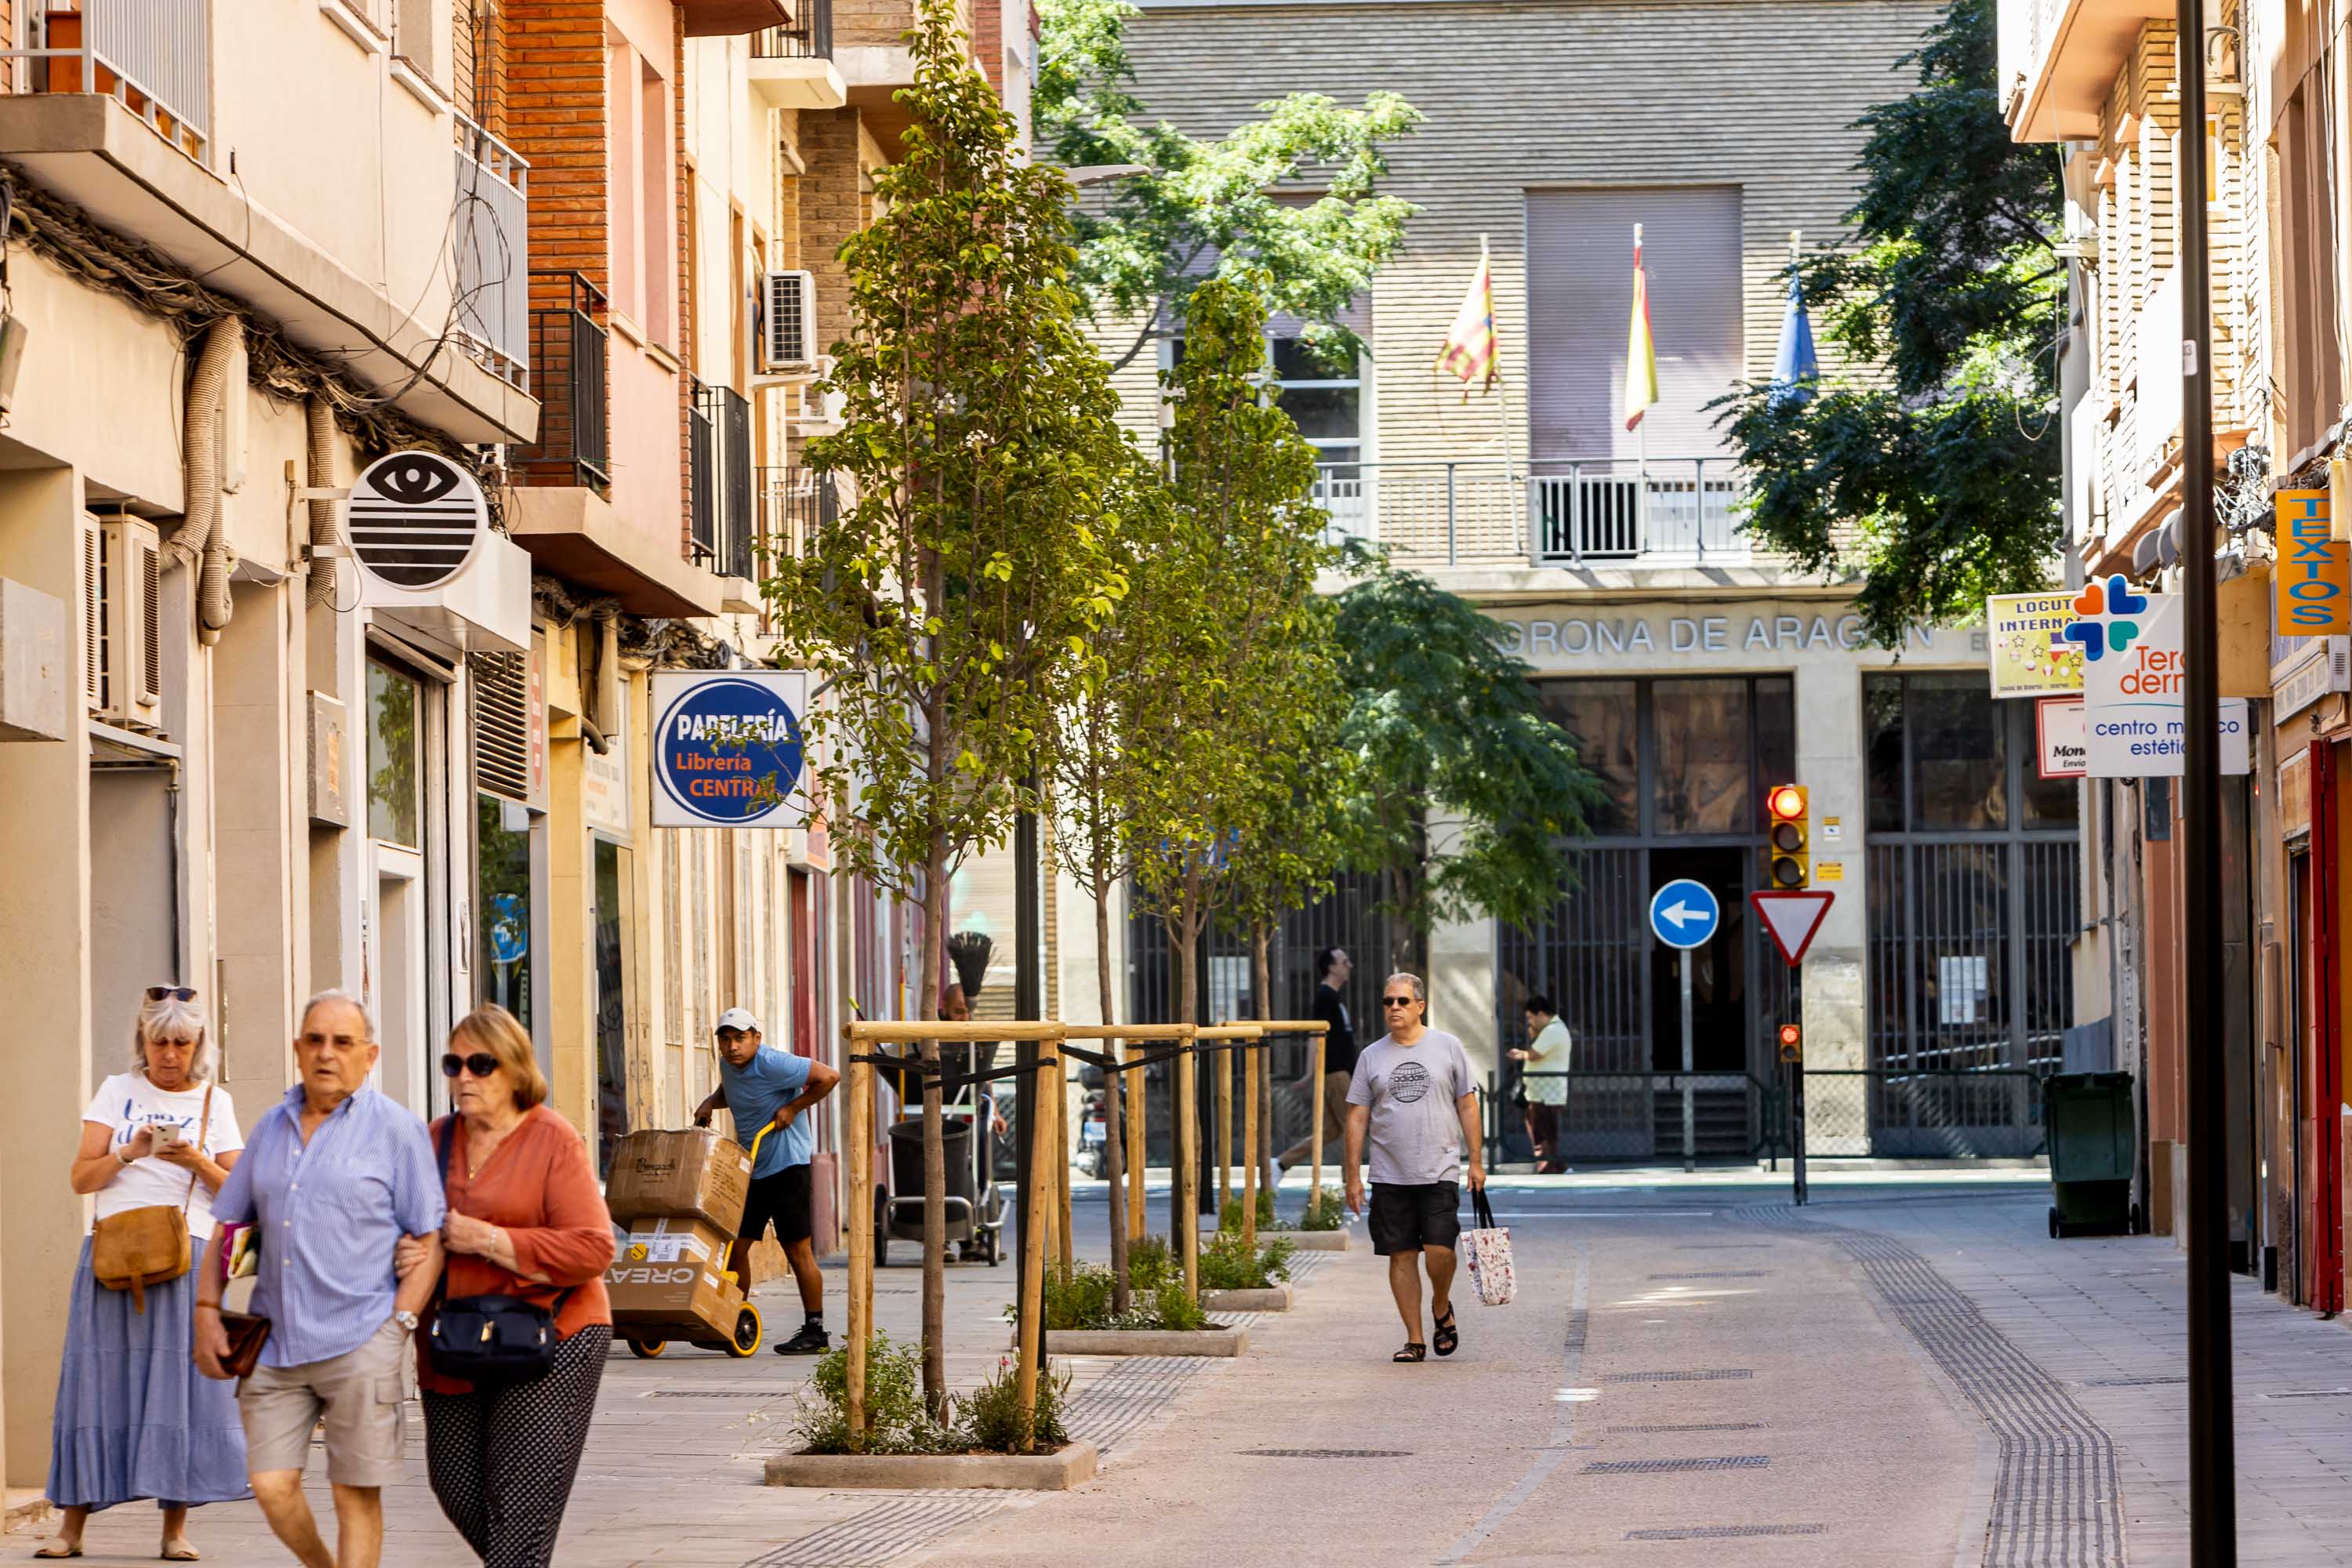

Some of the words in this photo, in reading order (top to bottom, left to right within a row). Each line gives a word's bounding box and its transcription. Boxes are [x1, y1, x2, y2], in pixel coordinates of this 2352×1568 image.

[2288, 498, 2340, 626] TEXTOS
[1670, 618, 1727, 652] DE
[1743, 614, 1933, 651] ARAGN
[2095, 719, 2158, 736] centro
[2167, 720, 2240, 735] mco
[677, 752, 751, 771] Librería
[1394, 1073, 1425, 1082] adidas
